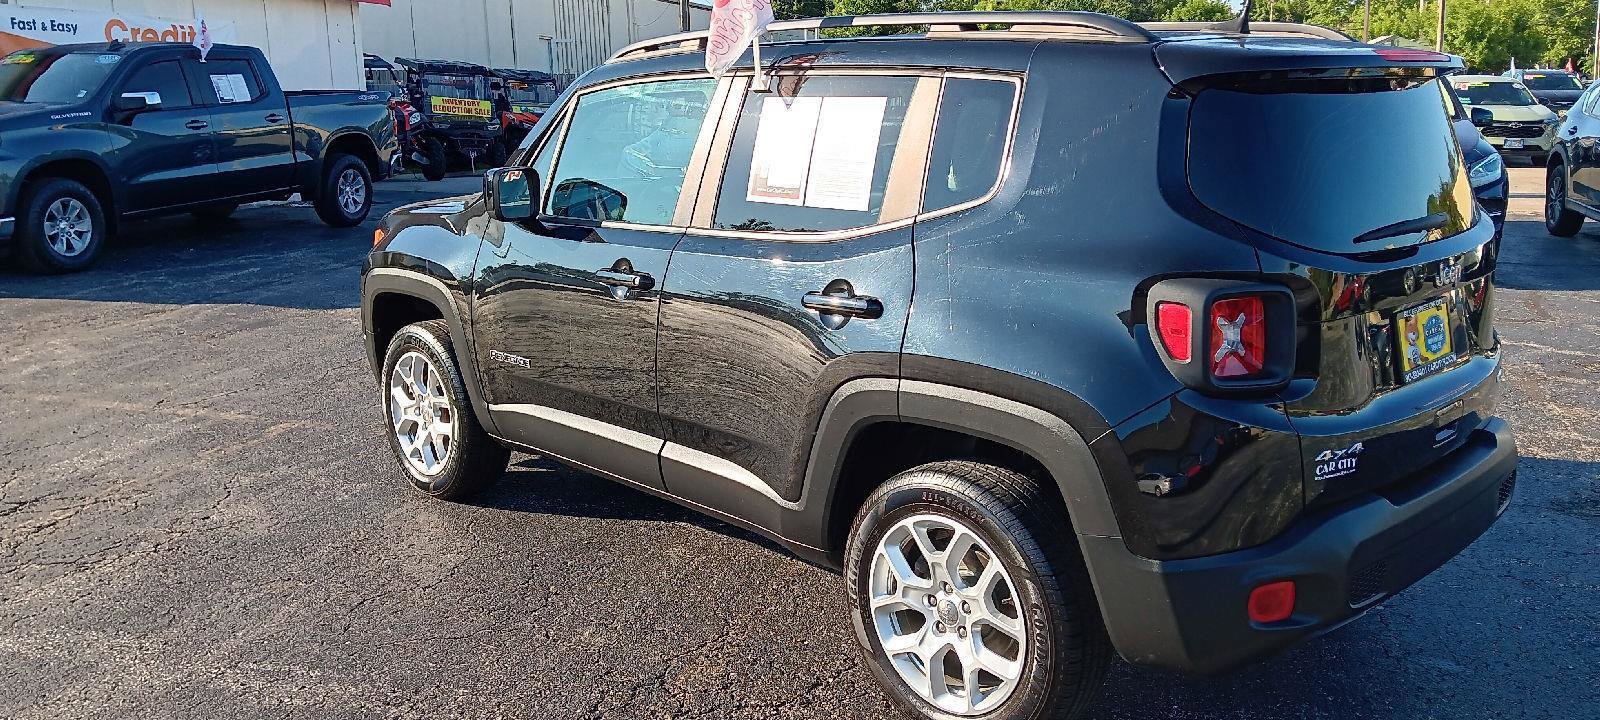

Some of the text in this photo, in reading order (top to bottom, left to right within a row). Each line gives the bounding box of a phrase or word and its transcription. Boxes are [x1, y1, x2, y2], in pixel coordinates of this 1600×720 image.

[10, 17, 78, 35] Fast & Easy
[105, 19, 196, 43] Credit
[433, 105, 491, 116] REDUCTION SALE
[441, 98, 481, 107] INVENTORY
[1315, 460, 1336, 475] CAR
[1338, 457, 1358, 470] CITY
